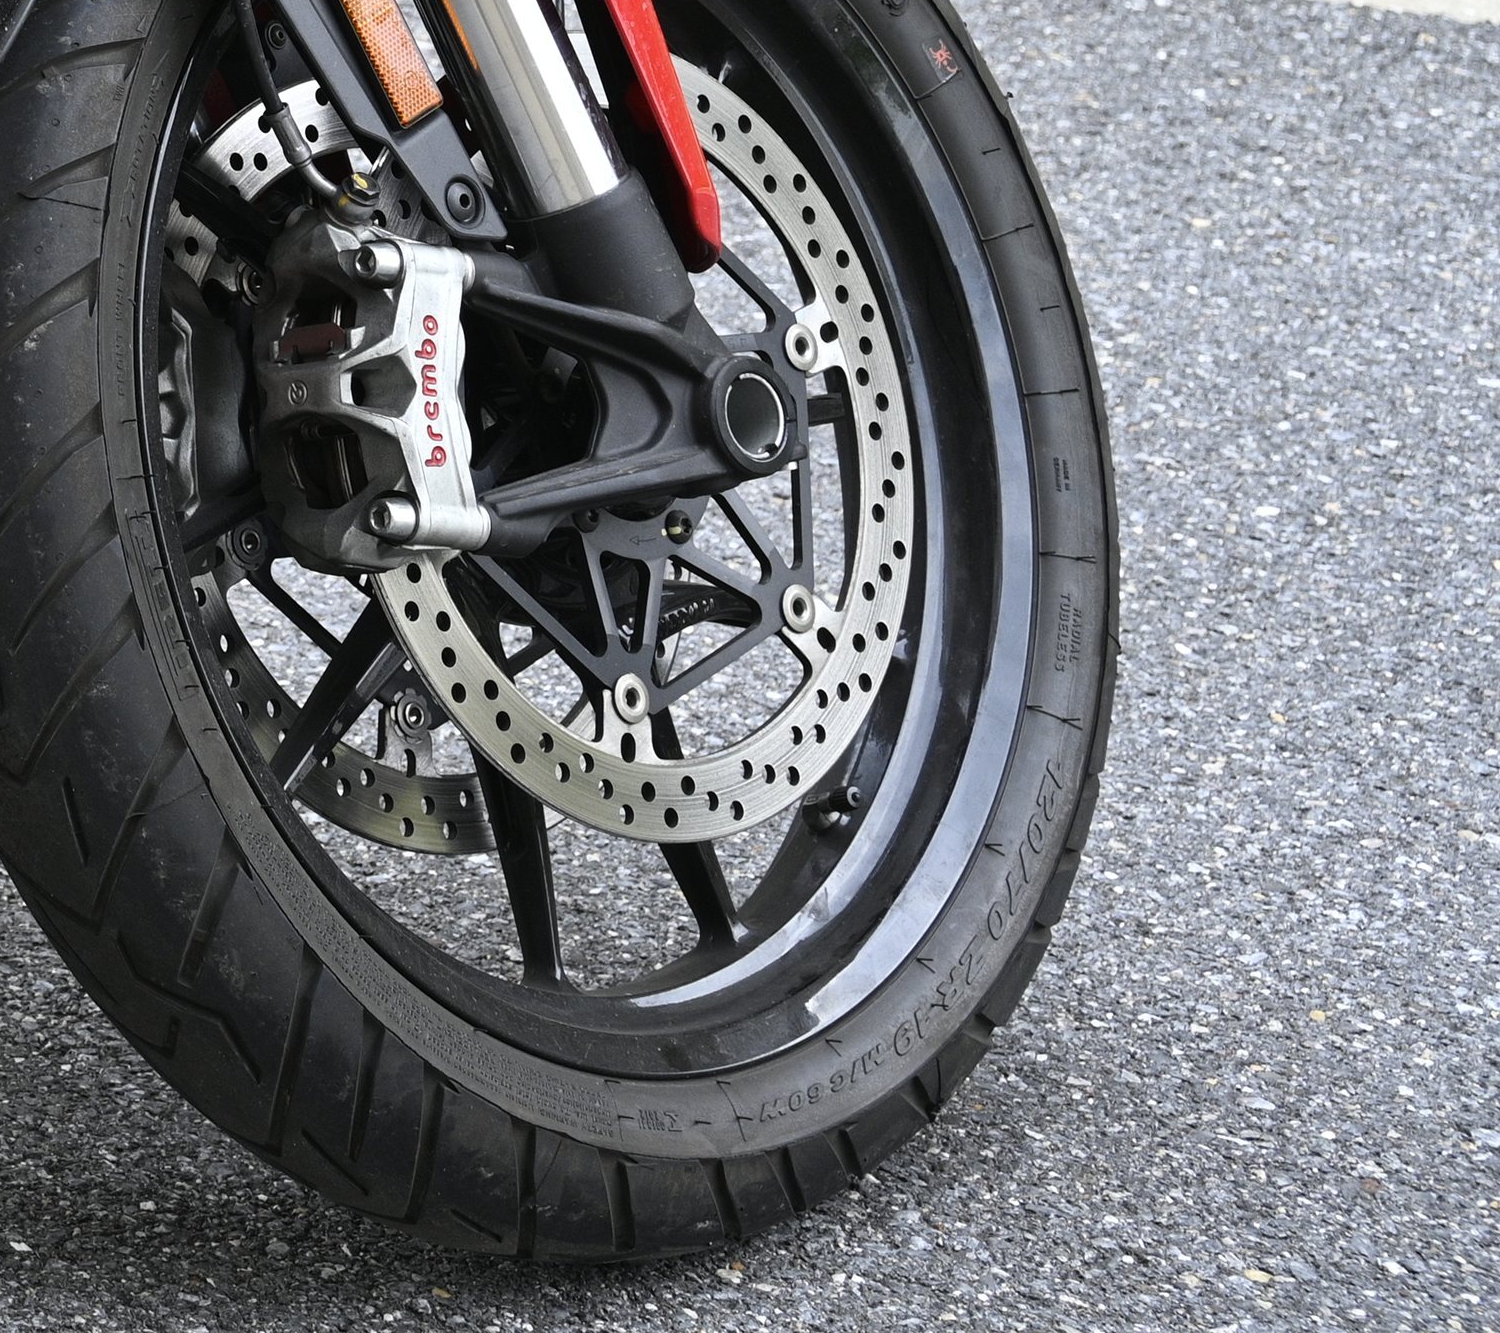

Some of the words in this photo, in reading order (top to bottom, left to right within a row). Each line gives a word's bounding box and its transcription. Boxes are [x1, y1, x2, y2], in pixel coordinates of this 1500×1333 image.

[414, 314, 447, 467] brembo
[1054, 592, 1071, 673] TUBELESS
[1070, 609, 1083, 664] RADIAL
[987, 759, 1063, 941] 120/70
